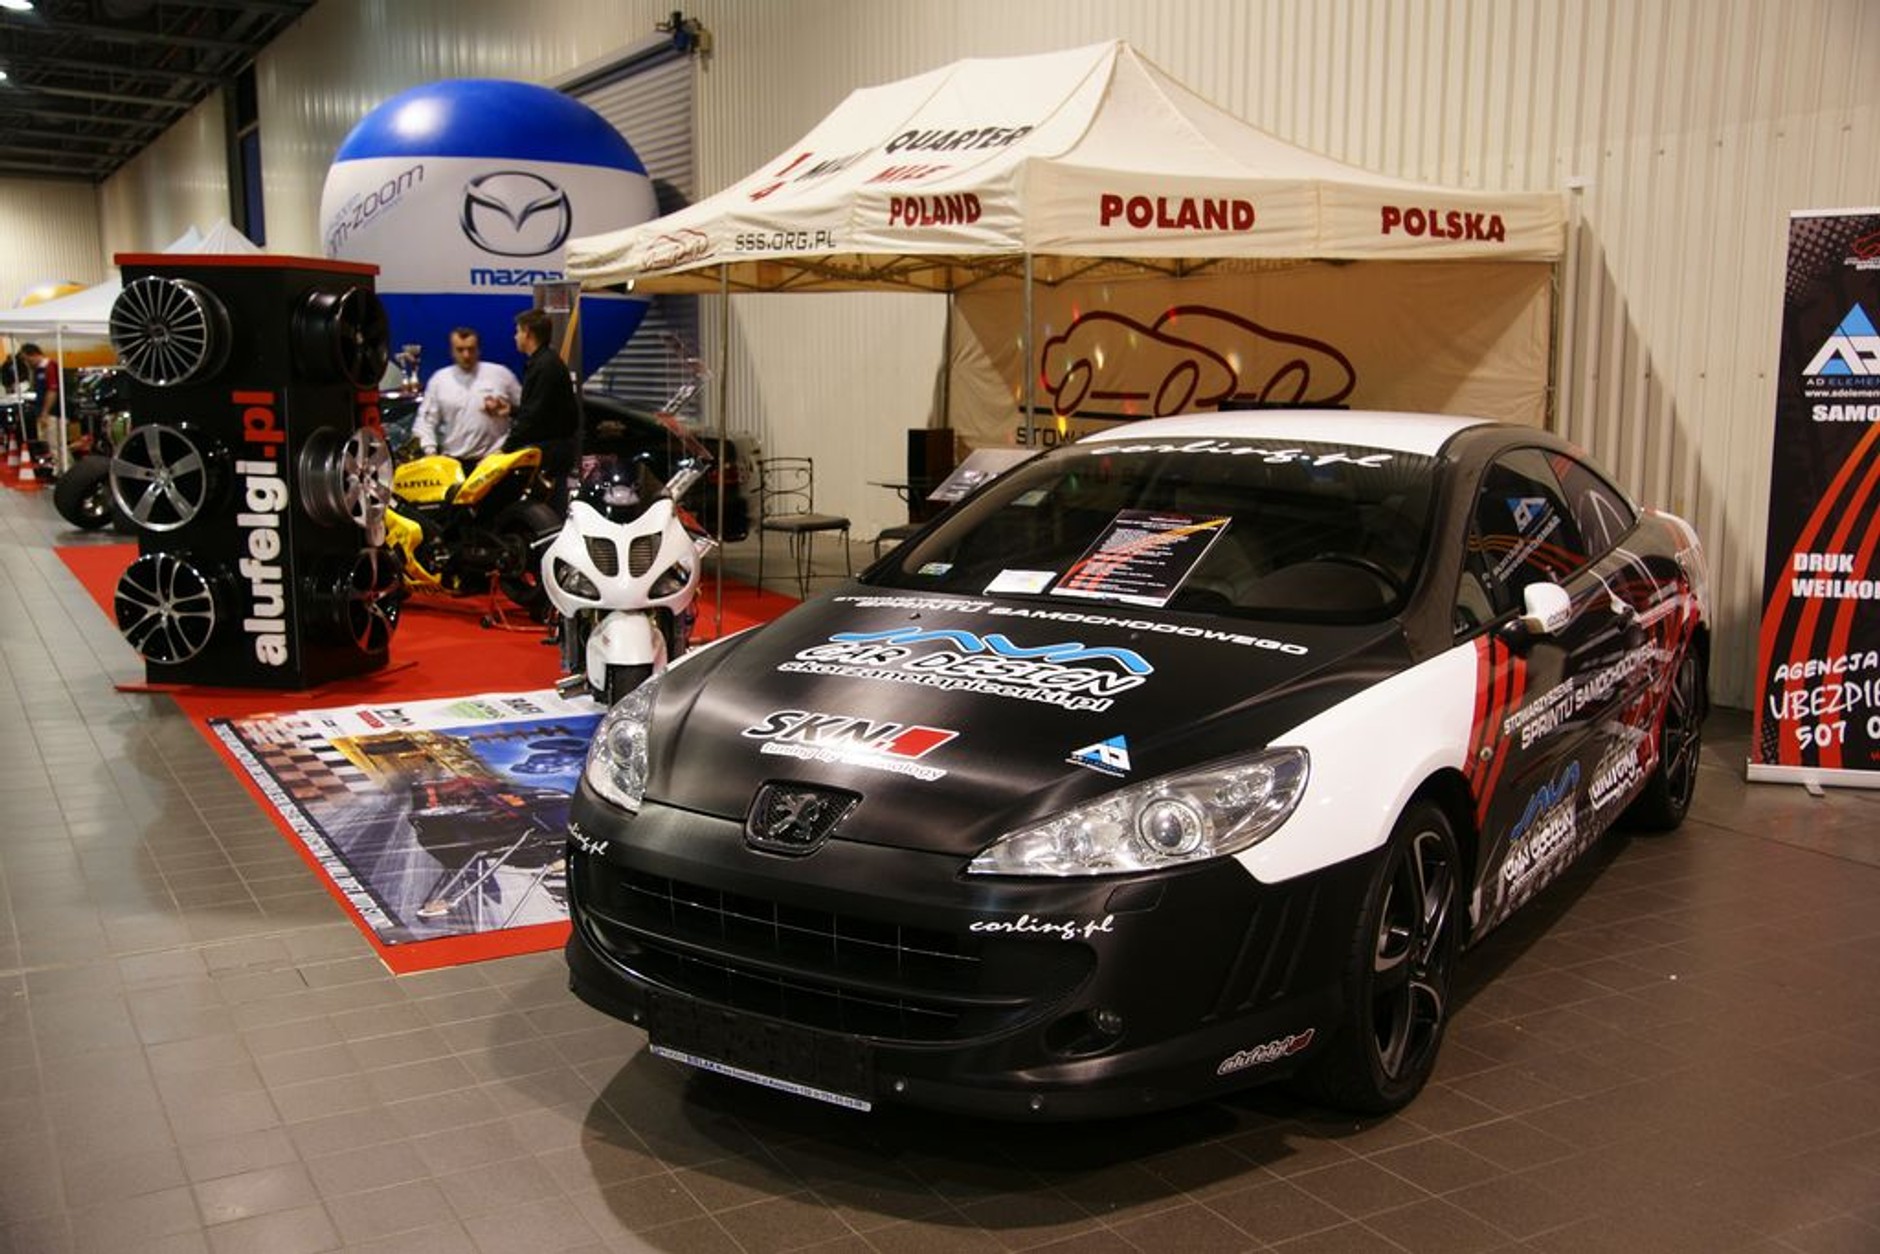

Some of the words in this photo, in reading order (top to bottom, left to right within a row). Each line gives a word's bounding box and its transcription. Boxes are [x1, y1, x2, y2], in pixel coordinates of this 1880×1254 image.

[885, 126, 1033, 153] QUARTER
[889, 192, 982, 227] POLAND
[1100, 194, 1256, 231] POLAND
[1381, 206, 1506, 242] POLSKA
[735, 231, 836, 251] SSS.ORG.PL
[1806, 378, 1825, 386] AD
[1812, 404, 1880, 422] SAMO
[231, 391, 289, 666] alufelgi.pl
[1793, 553, 1854, 573] DRUK
[988, 607, 1309, 656] SAMOCHODOWEGO
[795, 641, 912, 665] CAR
[902, 651, 1147, 696] DESIGN
[1773, 651, 1878, 682] AGENCJA
[1521, 697, 1574, 750] SPRINTU
[1795, 720, 1847, 750] 507
